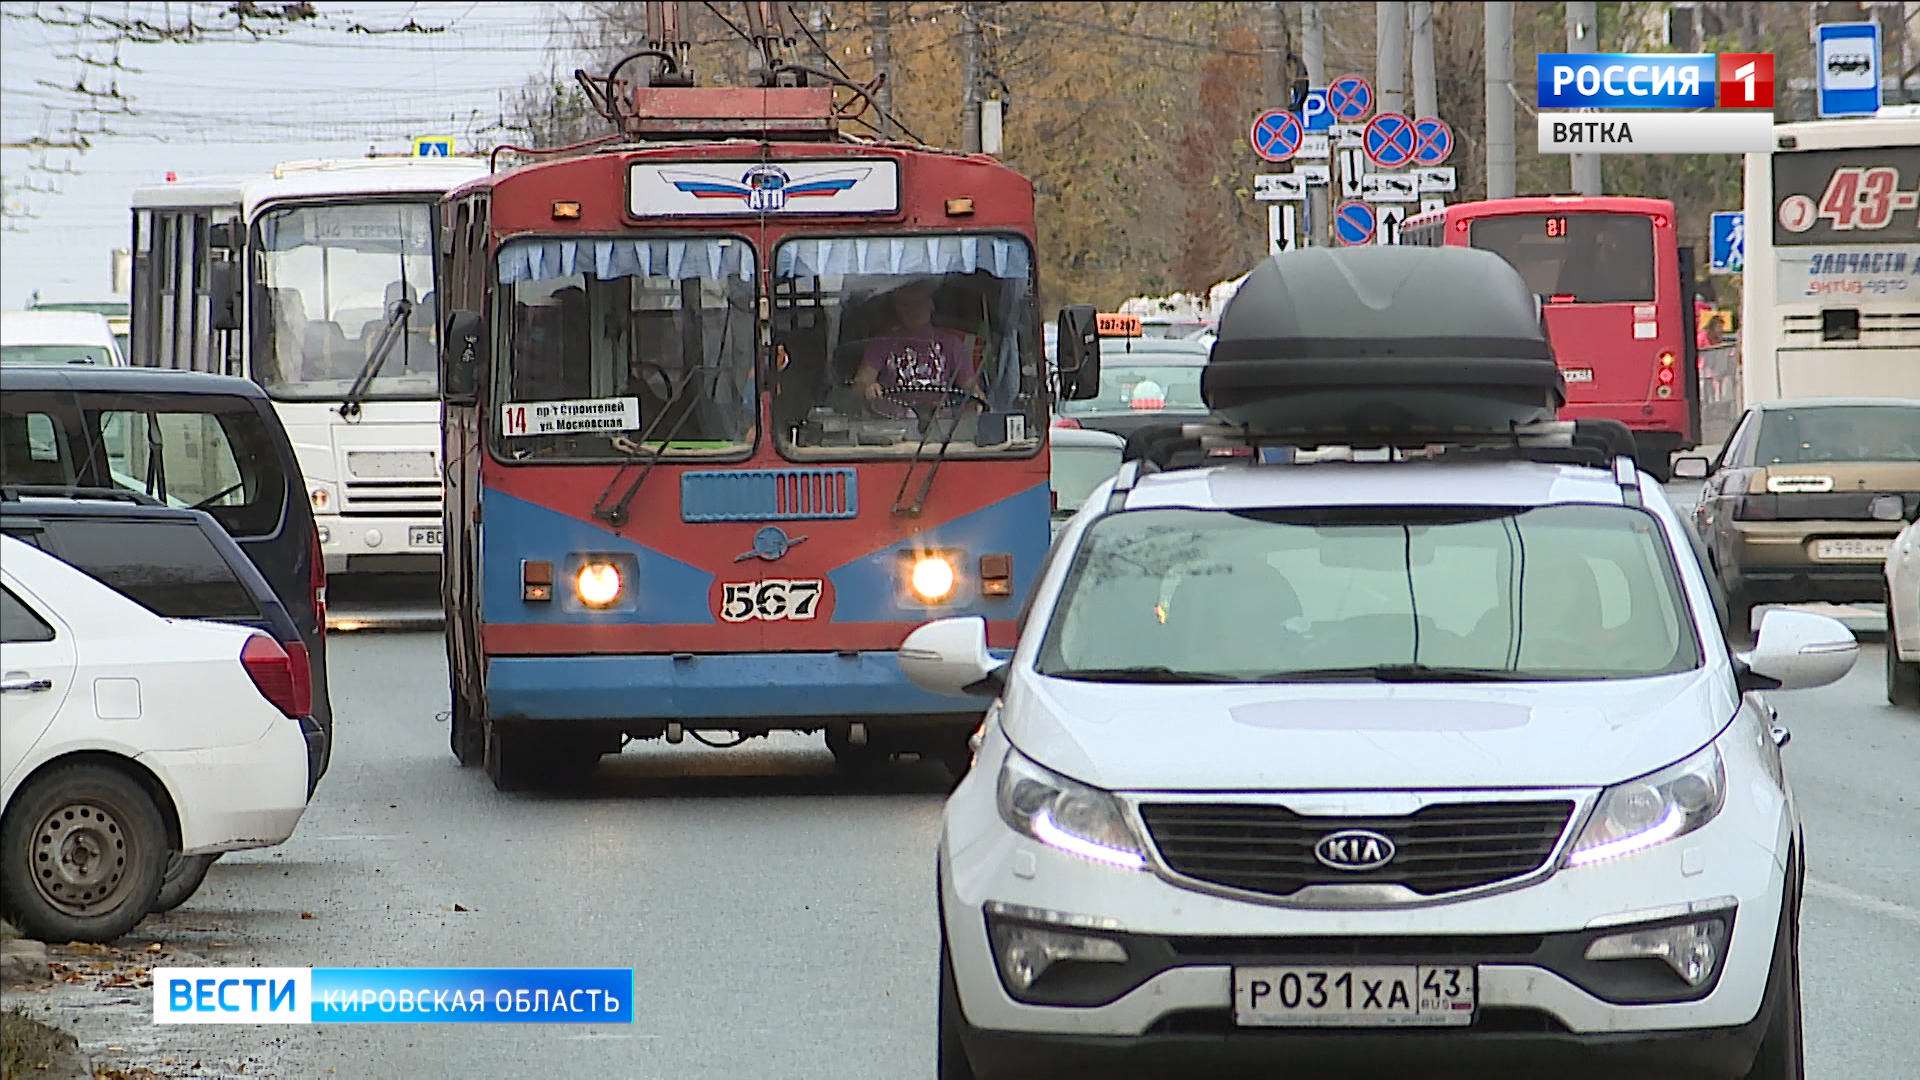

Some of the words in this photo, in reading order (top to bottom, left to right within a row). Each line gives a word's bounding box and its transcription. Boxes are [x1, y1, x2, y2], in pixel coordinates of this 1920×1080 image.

[750, 189, 784, 208] АТП
[1818, 166, 1920, 231] 43-
[1546, 217, 1566, 237] 81
[1809, 253, 1907, 275] ЗАПЧАСТИ
[560, 401, 625, 415] Строителей
[506, 407, 526, 433] 14
[556, 417, 622, 431] Московская
[723, 582, 820, 619] 567
[1329, 839, 1381, 861] KIA
[1250, 971, 1410, 1009] Р031ХА
[1423, 968, 1460, 998] 43
[1421, 999, 1449, 1010] RUS
